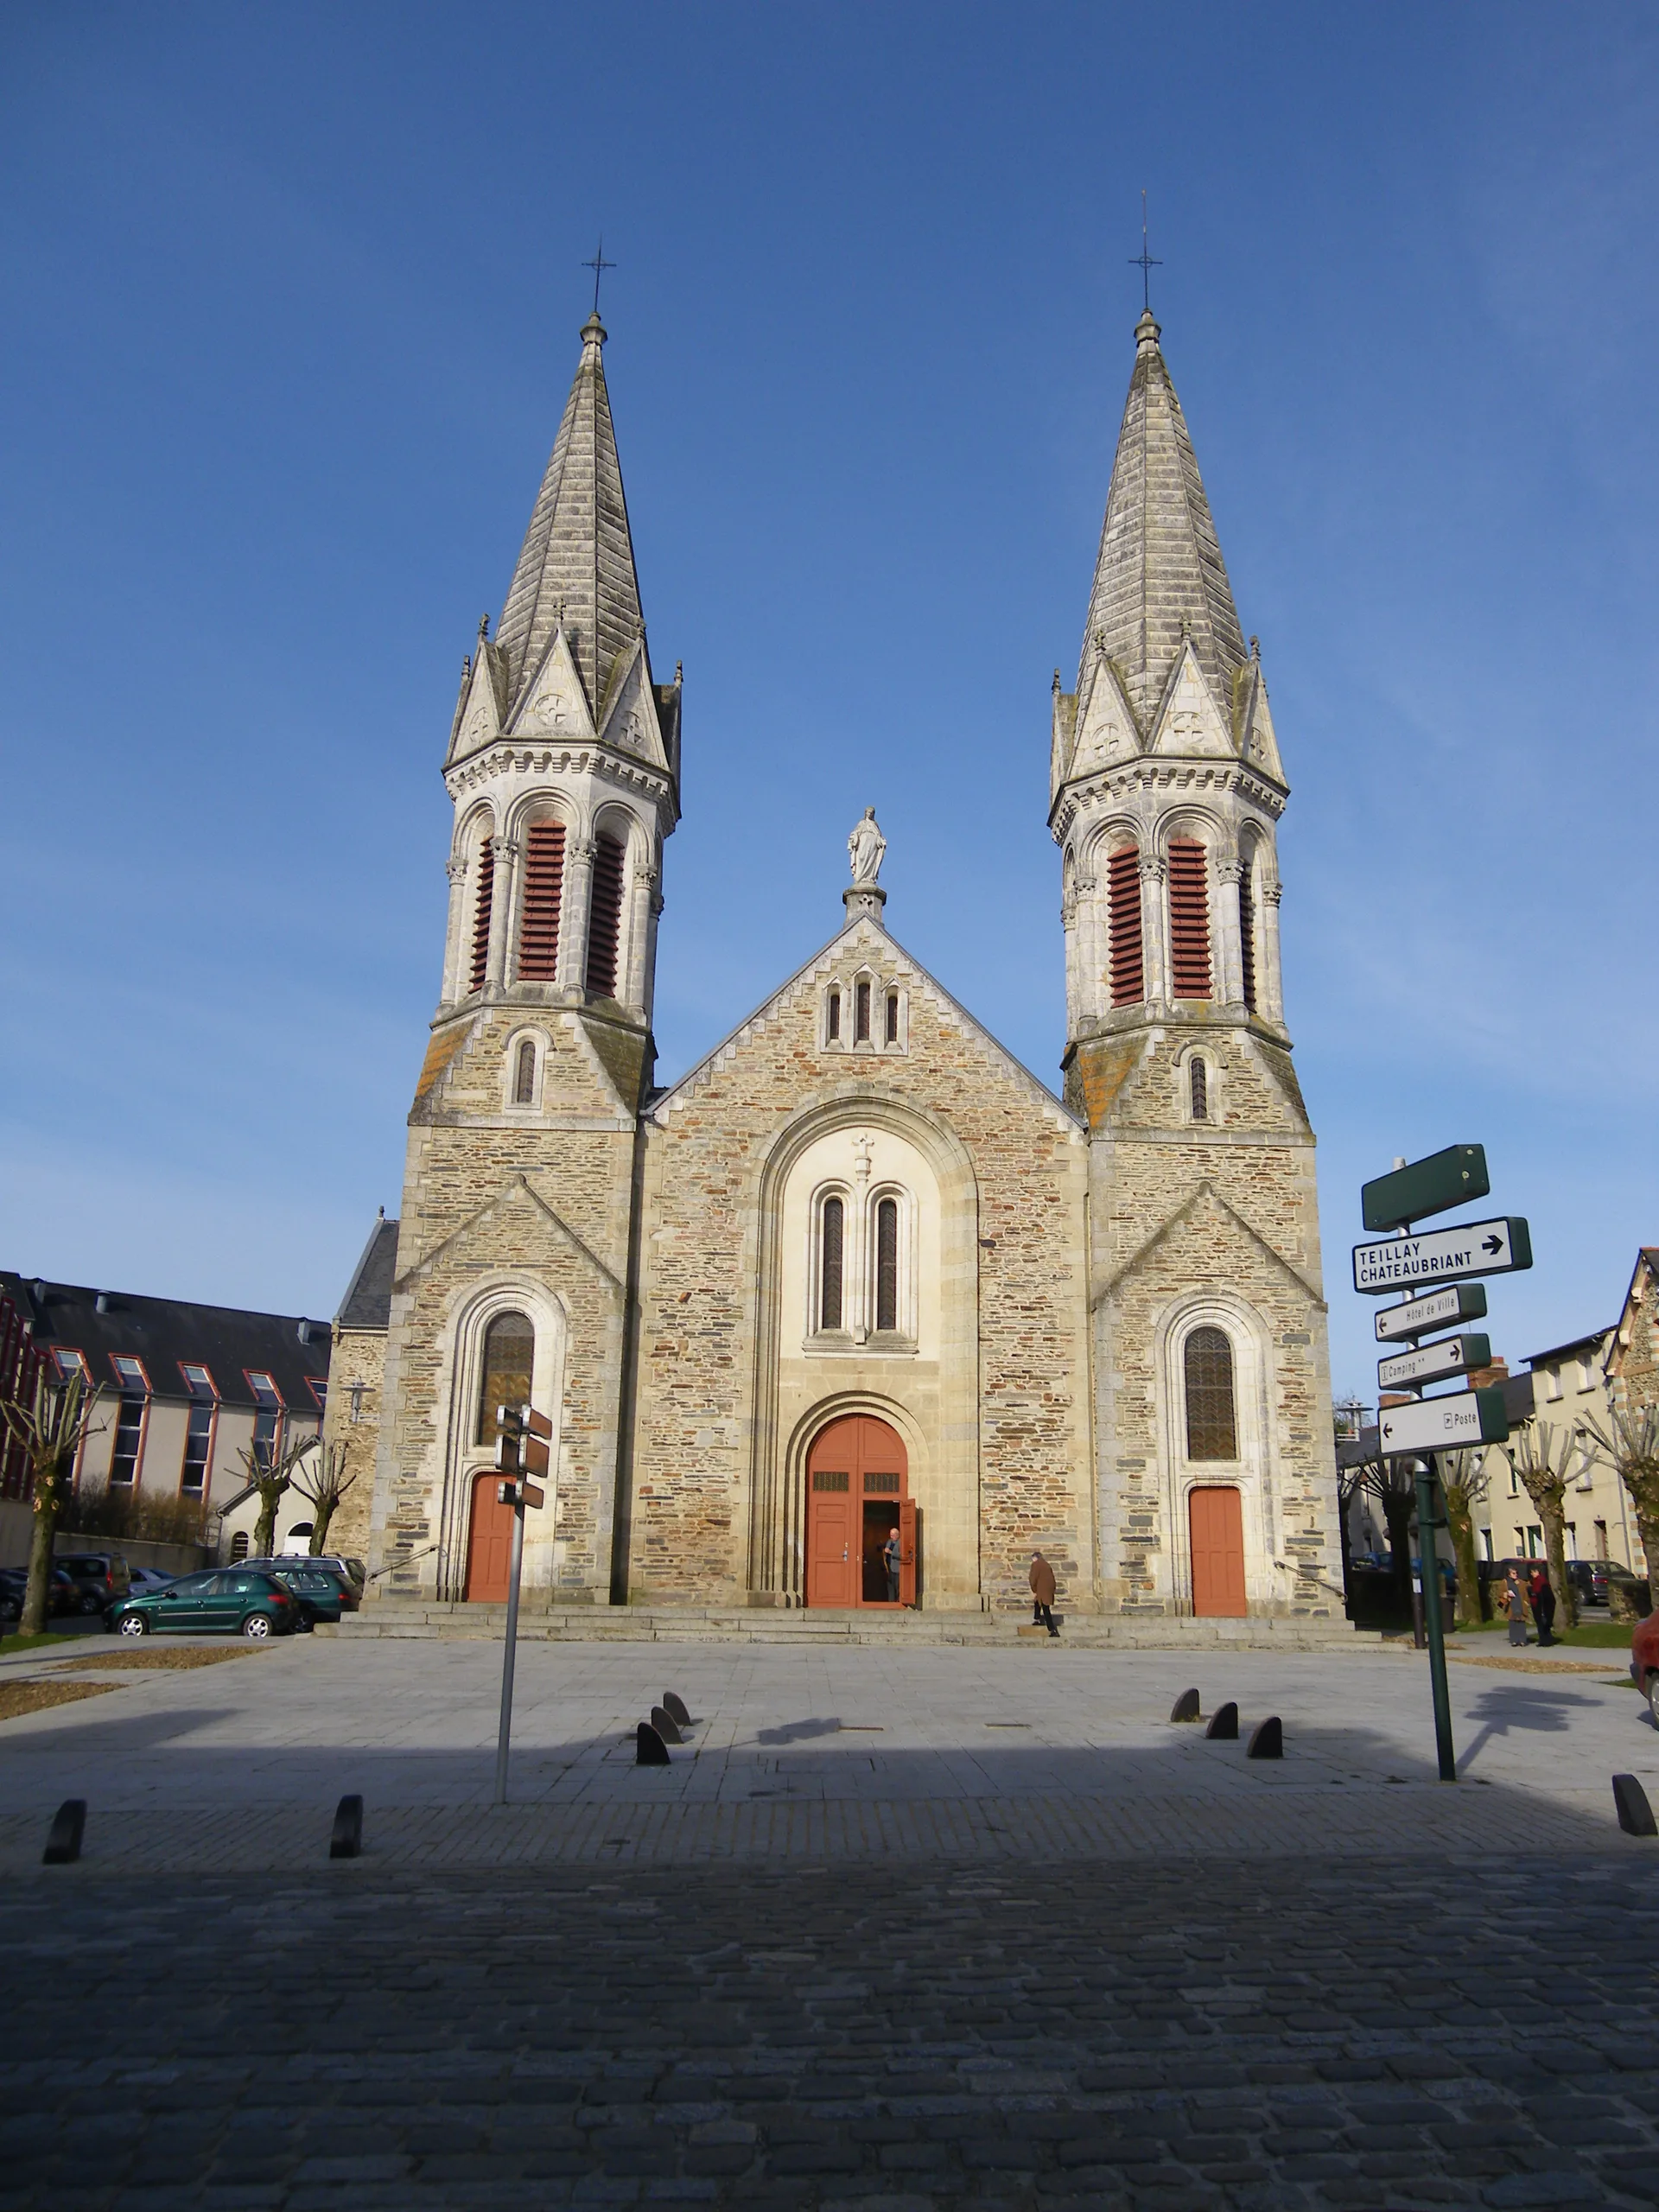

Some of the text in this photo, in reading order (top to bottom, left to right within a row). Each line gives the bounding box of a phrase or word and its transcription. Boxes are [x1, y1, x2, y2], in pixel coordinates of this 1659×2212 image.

[1359, 1242, 1421, 1265] TEILLAY
[1361, 1251, 1471, 1282] CHATEAUBRIANT
[1406, 1296, 1454, 1321] Hôtel de Ville
[1389, 1362, 1415, 1377] Camping
[1454, 1413, 1477, 1426] Poste
